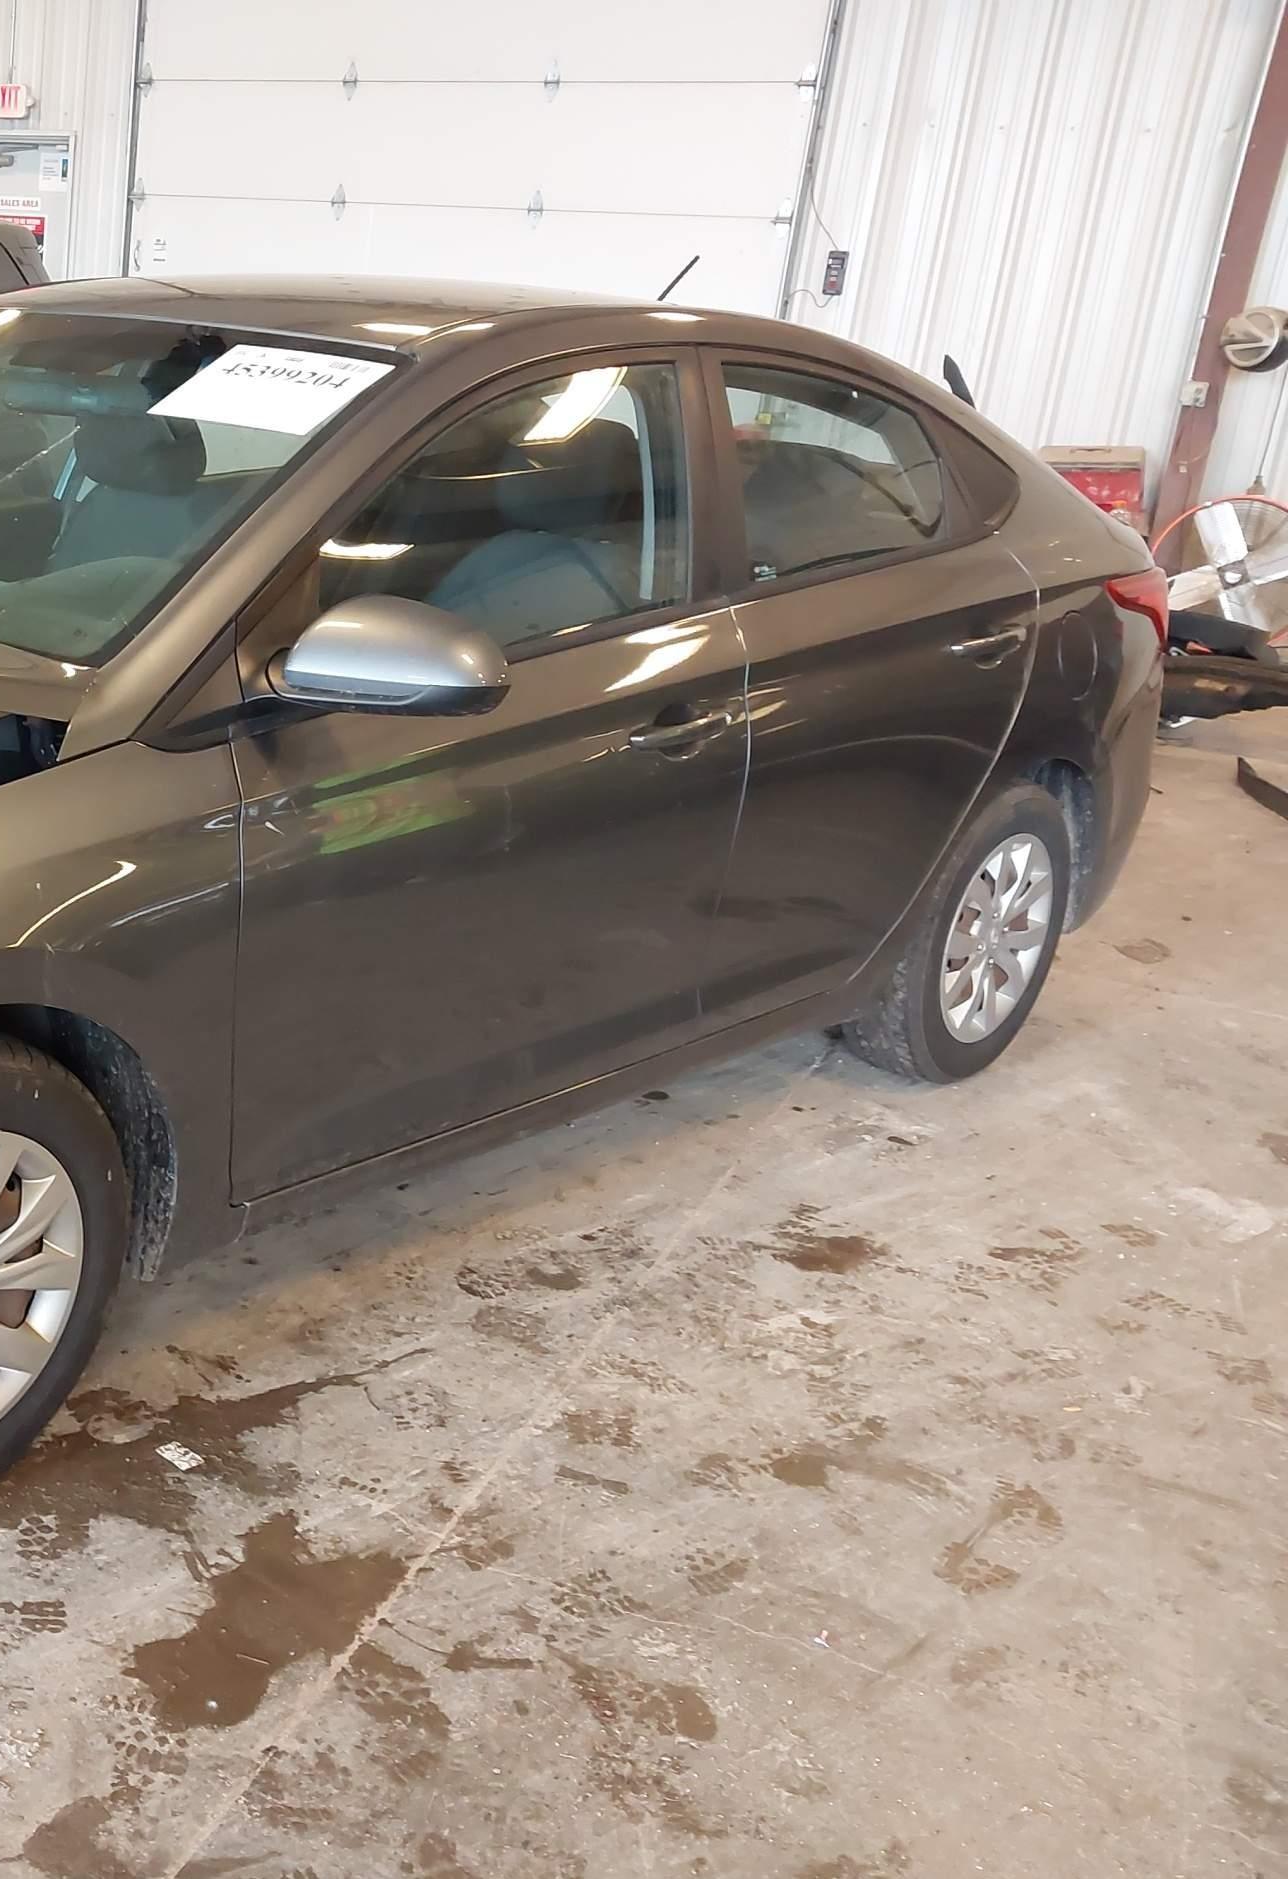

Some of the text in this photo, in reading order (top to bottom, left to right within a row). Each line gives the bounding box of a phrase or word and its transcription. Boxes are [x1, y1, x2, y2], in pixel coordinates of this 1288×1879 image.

[0, 199, 39, 208] SALES AREA
[222, 363, 351, 389] 45399204
